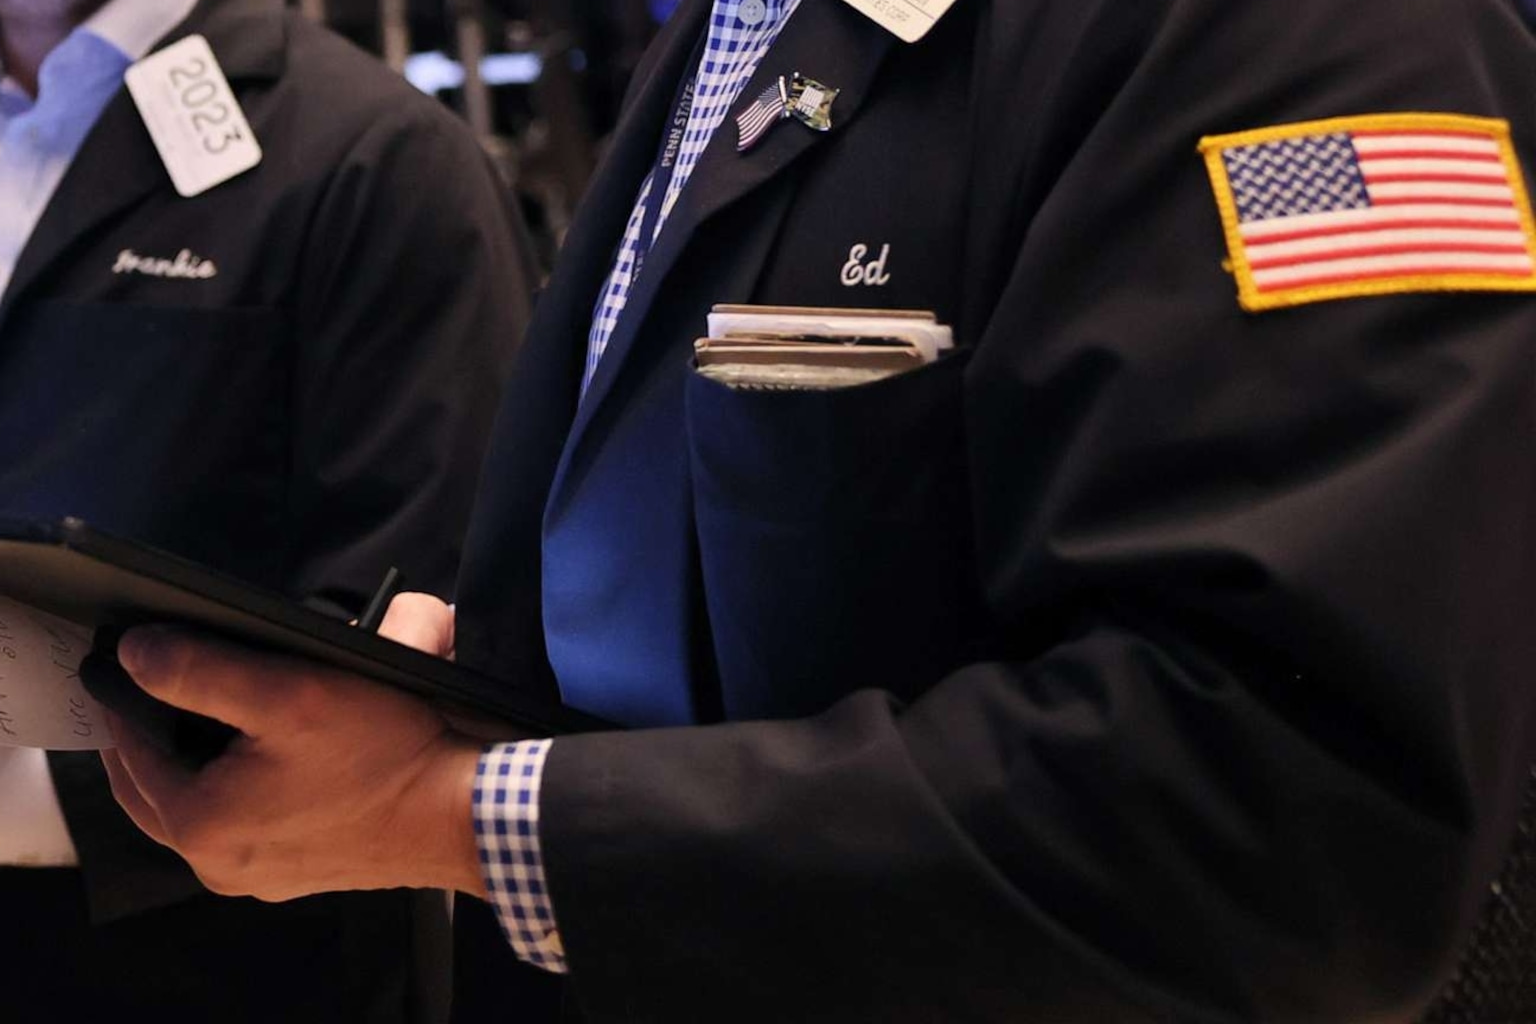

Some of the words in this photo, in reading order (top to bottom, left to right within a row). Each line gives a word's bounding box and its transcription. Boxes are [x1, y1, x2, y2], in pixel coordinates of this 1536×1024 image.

[168, 57, 243, 154] 2023
[661, 128, 683, 167] PENN
[840, 243, 891, 287] Ed
